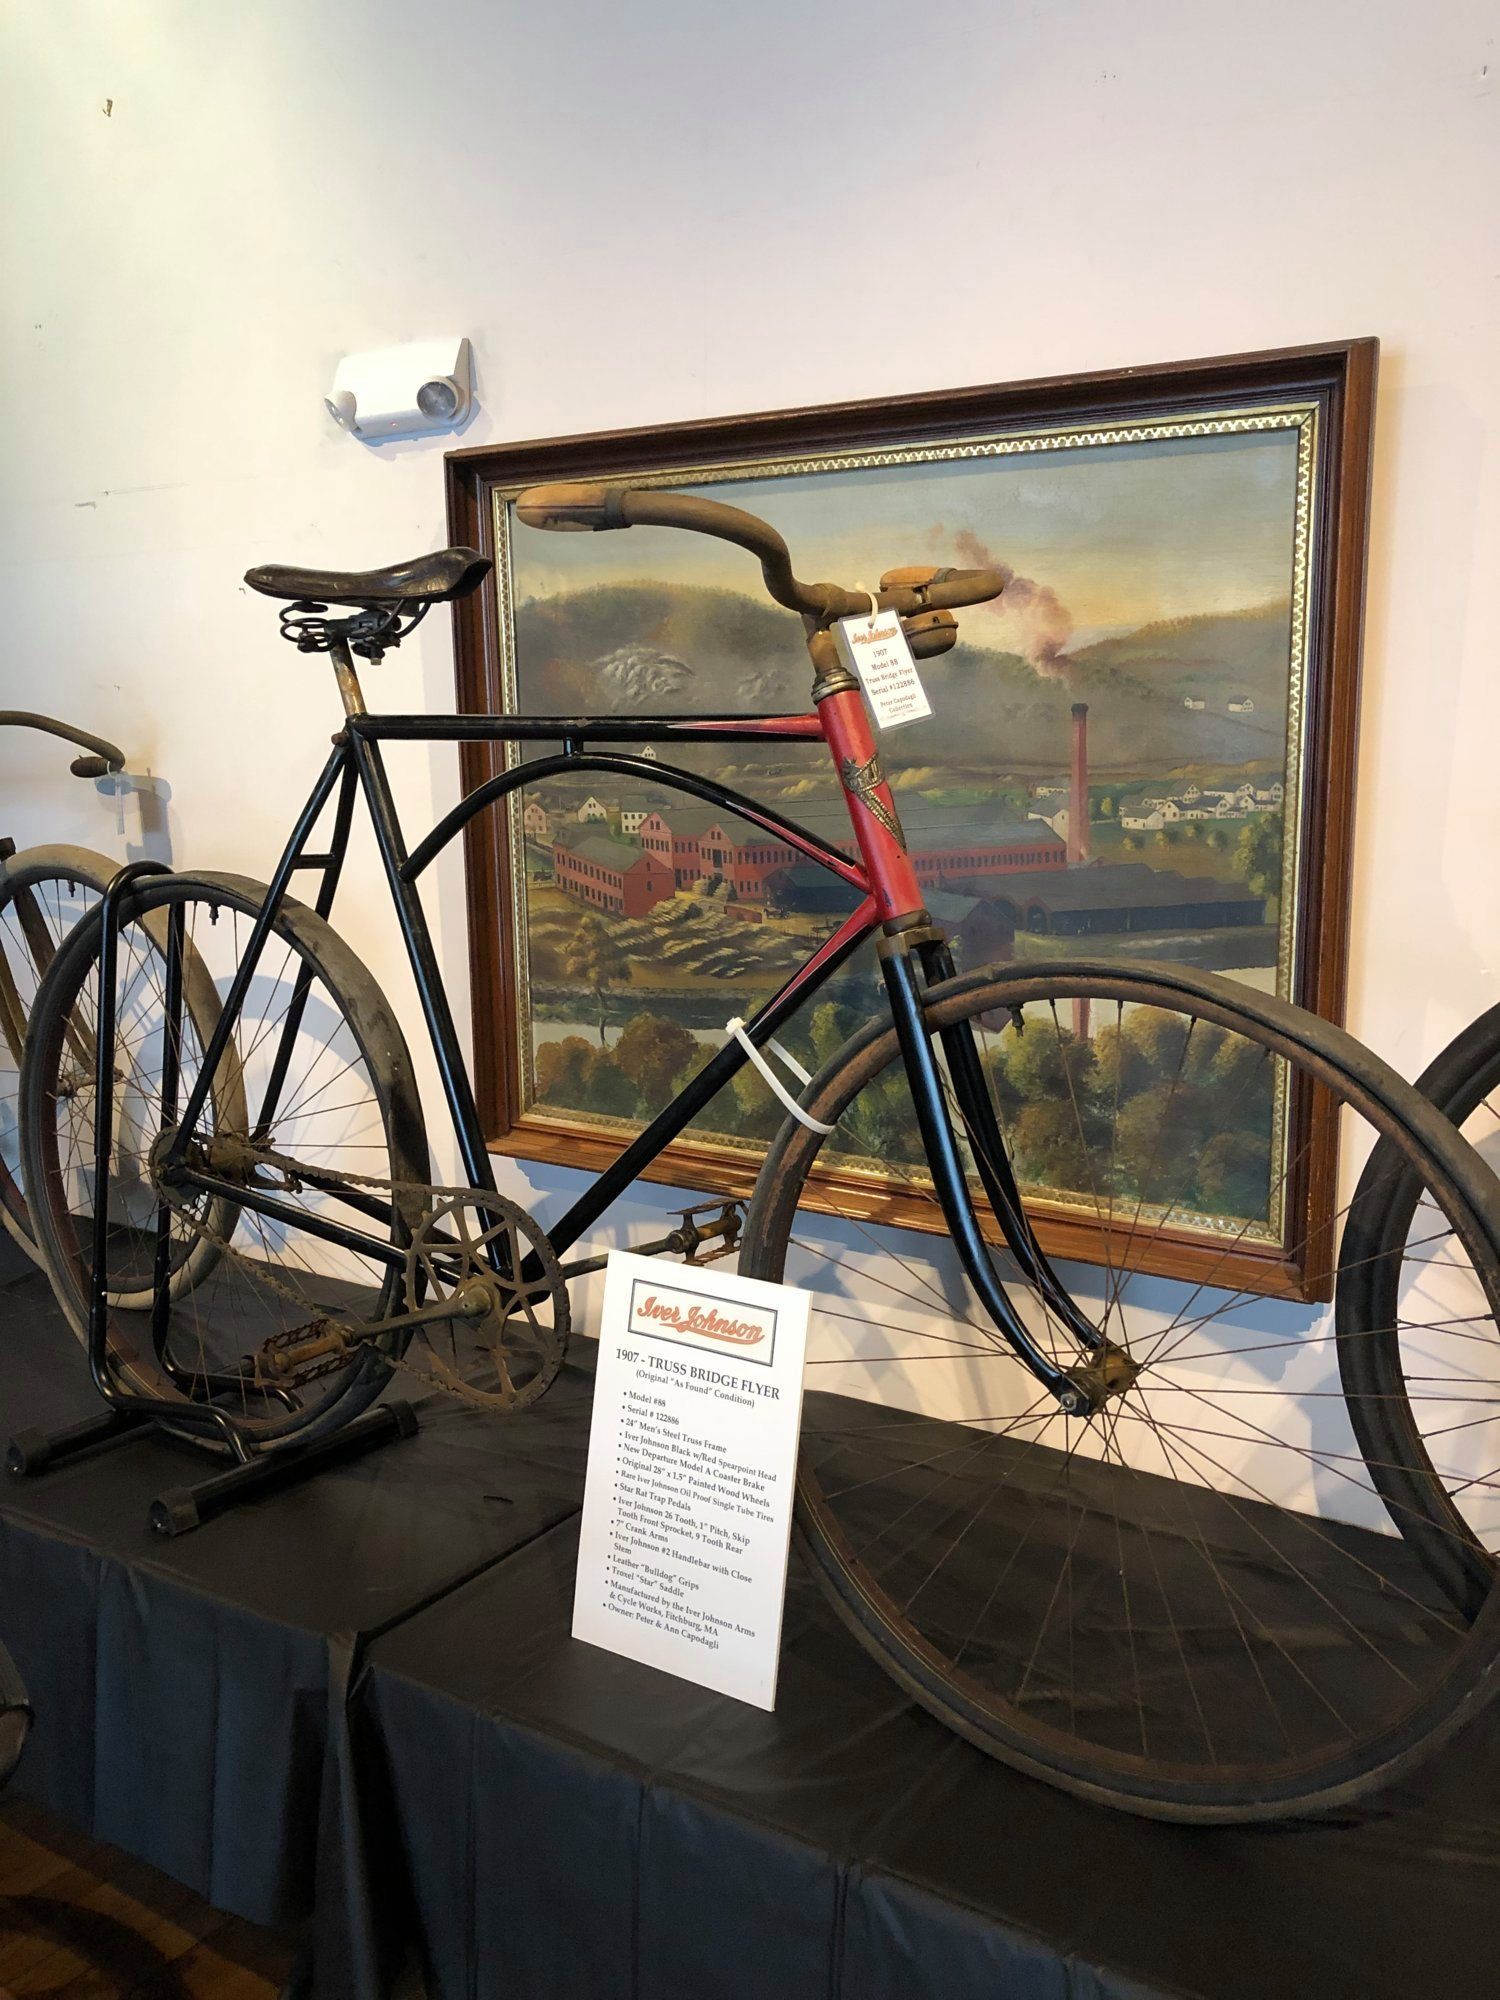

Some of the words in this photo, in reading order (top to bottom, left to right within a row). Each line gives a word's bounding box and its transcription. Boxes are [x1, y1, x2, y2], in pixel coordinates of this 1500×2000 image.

[871, 660, 889, 671] Model
[890, 658, 899, 667] 88
[873, 648, 888, 658] 1907
[871, 685, 889, 695] Serial
[881, 671, 898, 682] Bridge
[899, 667, 913, 678] Flyer
[880, 699, 893, 708] Peter
[637, 1296, 681, 1322] Iver
[674, 1306, 765, 1345] Johnson
[616, 1348, 640, 1363] 1907
[648, 1355, 687, 1376] TRUSS
[690, 1366, 738, 1389] BRIDGE
[741, 1379, 780, 1400] FLYER
[636, 1369, 669, 1384] (Original
[714, 1389, 755, 1408] Condition)
[627, 1404, 648, 1417] Serial
[656, 1412, 680, 1425] 122886
[629, 1390, 652, 1404] Model
[653, 1398, 666, 1407] #88
[625, 1430, 639, 1442] Iver
[639, 1435, 670, 1451] Johnson
[671, 1444, 691, 1457] Black
[693, 1452, 717, 1464] w/Red
[718, 1458, 756, 1476] Spearpoint
[757, 1470, 777, 1482] Head
[639, 1421, 661, 1435] Men's
[662, 1428, 681, 1440] Steel
[682, 1433, 702, 1446] Truss
[704, 1439, 727, 1454] Frame
[622, 1456, 652, 1472] Original
[688, 1476, 716, 1492] Painted
[718, 1484, 740, 1499] Wood
[741, 1492, 770, 1508] Wheels
[623, 1443, 640, 1454] New
[642, 1448, 678, 1466] Departure
[679, 1459, 704, 1473] Model
[705, 1467, 711, 1476] A
[713, 1469, 741, 1484] Coaster
[743, 1477, 765, 1492] Brake
[619, 1482, 634, 1493] Star
[635, 1487, 648, 1498] Rat
[649, 1491, 666, 1505] Trap
[667, 1497, 691, 1511] Pedals
[621, 1469, 636, 1481] Rare
[637, 1474, 650, 1485] Iver
[651, 1479, 679, 1494] Johnson
[679, 1488, 691, 1497] Oil
[692, 1491, 712, 1503] Proof
[712, 1497, 735, 1511] Single
[736, 1504, 754, 1517] Tube
[756, 1511, 774, 1523] Tires
[617, 1507, 638, 1521] Tooth
[639, 1514, 659, 1527] Front
[695, 1532, 700, 1540] 9
[701, 1534, 724, 1548] Tooth
[725, 1542, 743, 1555] Rear
[618, 1496, 633, 1507] Iver
[633, 1501, 663, 1517] Johnson
[664, 1510, 673, 1520] 26
[710, 1524, 730, 1540] Pitch,
[732, 1532, 750, 1547] Skip
[625, 1522, 647, 1536] Crank
[648, 1530, 668, 1543] Arms
[614, 1542, 632, 1555] Stem
[615, 1531, 629, 1542] Iver
[630, 1536, 660, 1552] Johnson
[661, 1547, 671, 1556] #2
[671, 1549, 711, 1569] Handlebar
[712, 1565, 729, 1576] with
[731, 1570, 752, 1583] Close
[612, 1565, 634, 1580] Troxel
[659, 1582, 685, 1598] Saddle
[613, 1554, 639, 1570] Leather
[678, 1576, 699, 1591] Grips
[609, 1591, 616, 1600] &
[617, 1593, 637, 1607] Cycle
[638, 1600, 664, 1618] Works,
[704, 1624, 718, 1636] MA
[610, 1579, 660, 1603] Manufactured
[661, 1597, 671, 1609] by
[672, 1602, 684, 1612] the
[685, 1606, 701, 1618] Iver
[702, 1611, 733, 1629] Johnson
[734, 1624, 755, 1637] Arms
[635, 1612, 654, 1625] Peter
[655, 1620, 662, 1629] &
[664, 1623, 680, 1635] Ann
[681, 1629, 719, 1650] Capodagli
